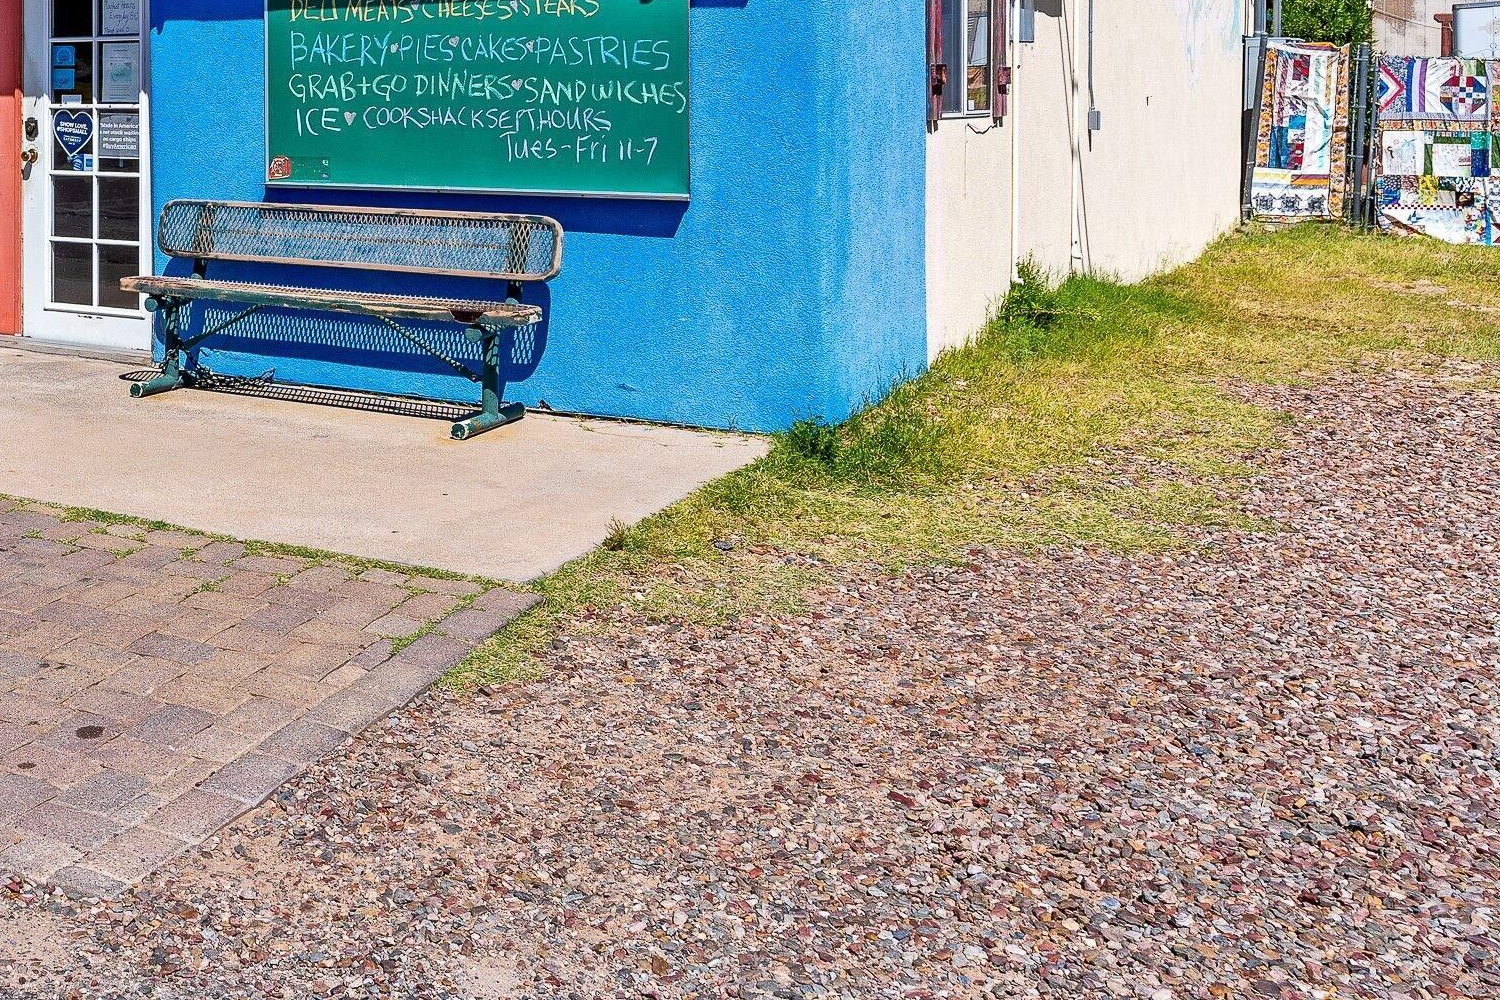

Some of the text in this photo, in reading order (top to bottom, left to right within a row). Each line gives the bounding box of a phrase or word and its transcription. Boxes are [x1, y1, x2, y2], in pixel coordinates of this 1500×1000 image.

[290, 30, 670, 71] BAKERY PIES CAKES PASTRIES
[414, 68, 515, 100] DINNERS
[524, 77, 687, 113] SANDWICHES
[296, 107, 342, 136] ICE
[540, 107, 612, 132] HOURS
[619, 136, 658, 166] 11-7
